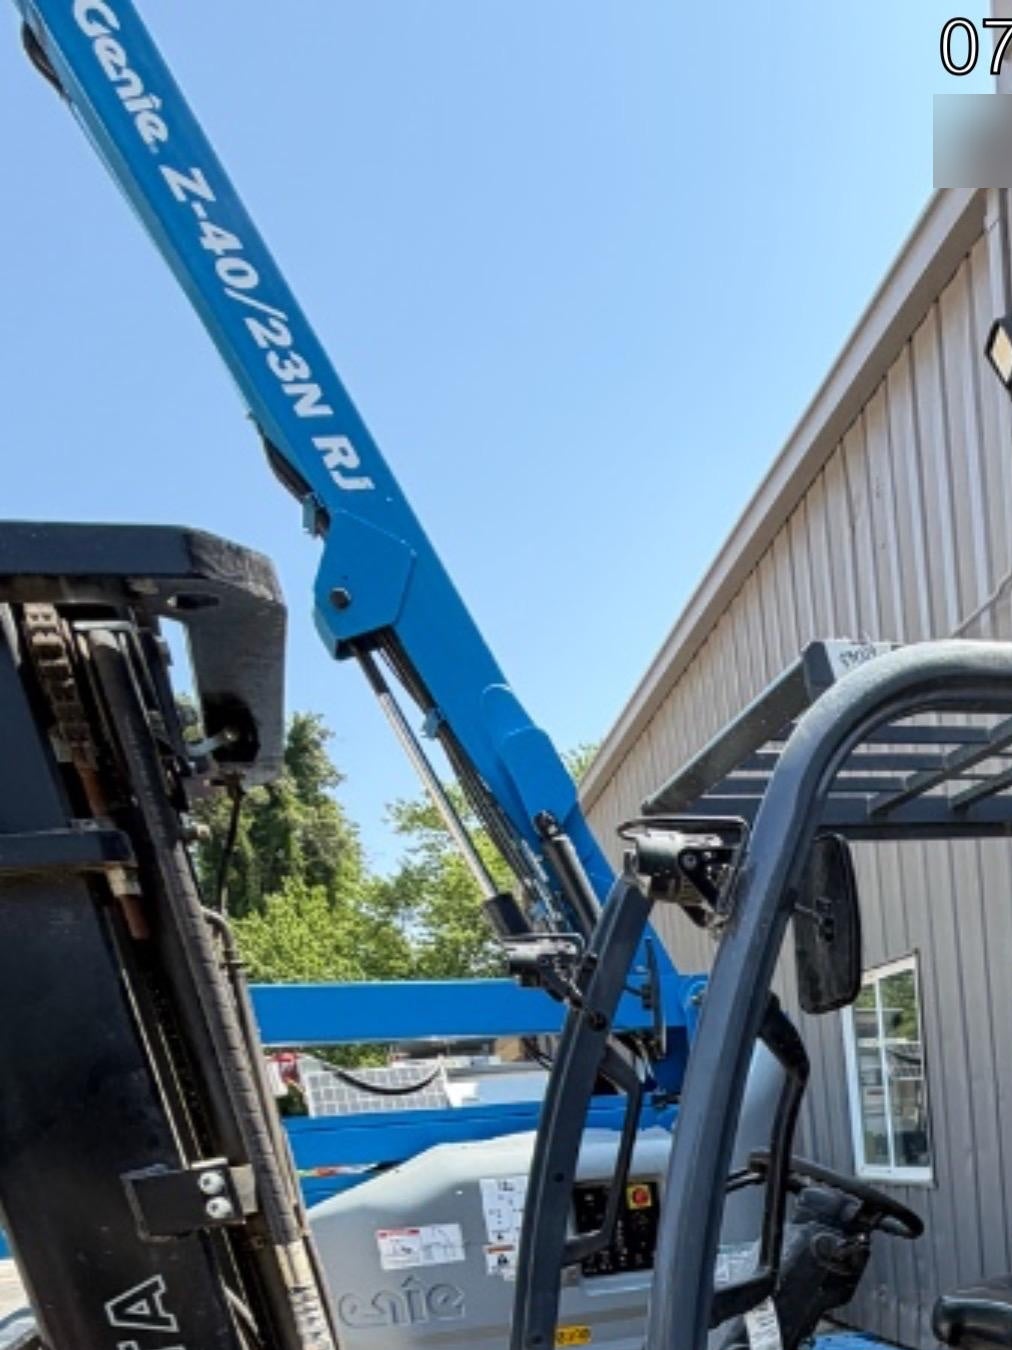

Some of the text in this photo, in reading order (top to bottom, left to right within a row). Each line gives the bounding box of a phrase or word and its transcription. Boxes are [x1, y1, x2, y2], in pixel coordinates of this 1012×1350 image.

[74, 0, 376, 490] Genie Z-40/23N RJ
[338, 1274, 465, 1329] enie
